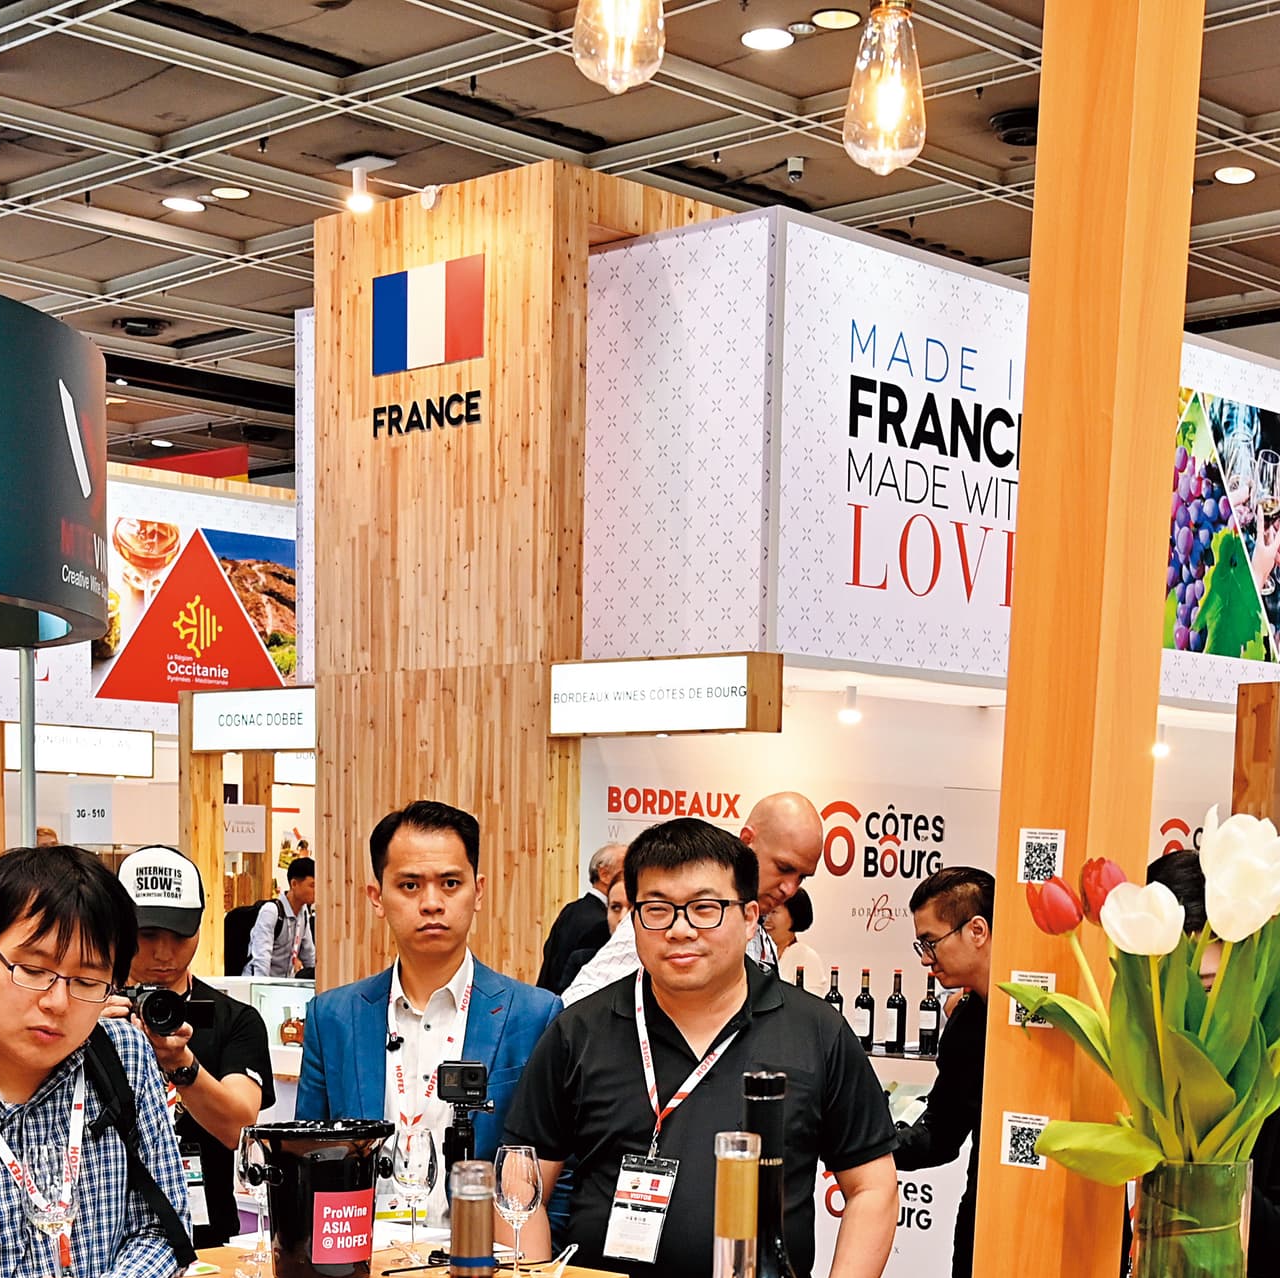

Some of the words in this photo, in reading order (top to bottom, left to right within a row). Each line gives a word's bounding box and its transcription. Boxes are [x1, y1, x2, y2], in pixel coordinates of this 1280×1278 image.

[849, 319, 979, 392] MADE
[372, 390, 482, 439] FRANCE
[848, 374, 1021, 468] FRANC
[845, 447, 947, 512] MADE
[960, 475, 1018, 521] WIT
[61, 564, 91, 590] Creative
[166, 661, 230, 678] Occitanie
[552, 690, 610, 704] BORDEAUX
[612, 688, 647, 702] WINES
[688, 686, 703, 699] DE
[706, 684, 748, 699] BOURG
[217, 713, 263, 728] COGNAC
[76, 807, 87, 819] 3G
[92, 807, 106, 819] 510
[607, 785, 742, 820] BORDEAUX
[135, 866, 173, 877] INTERNET
[174, 868, 182, 878] IS
[136, 876, 173, 891] SLOW
[459, 983, 472, 1013] HOFEX
[695, 1050, 719, 1078] HOFEX
[395, 1064, 405, 1095] HOFEX
[322, 1204, 368, 1219] ProWine
[322, 1220, 352, 1235] ASIA
[322, 1237, 335, 1250] @
[336, 1233, 369, 1250] HOFEX
